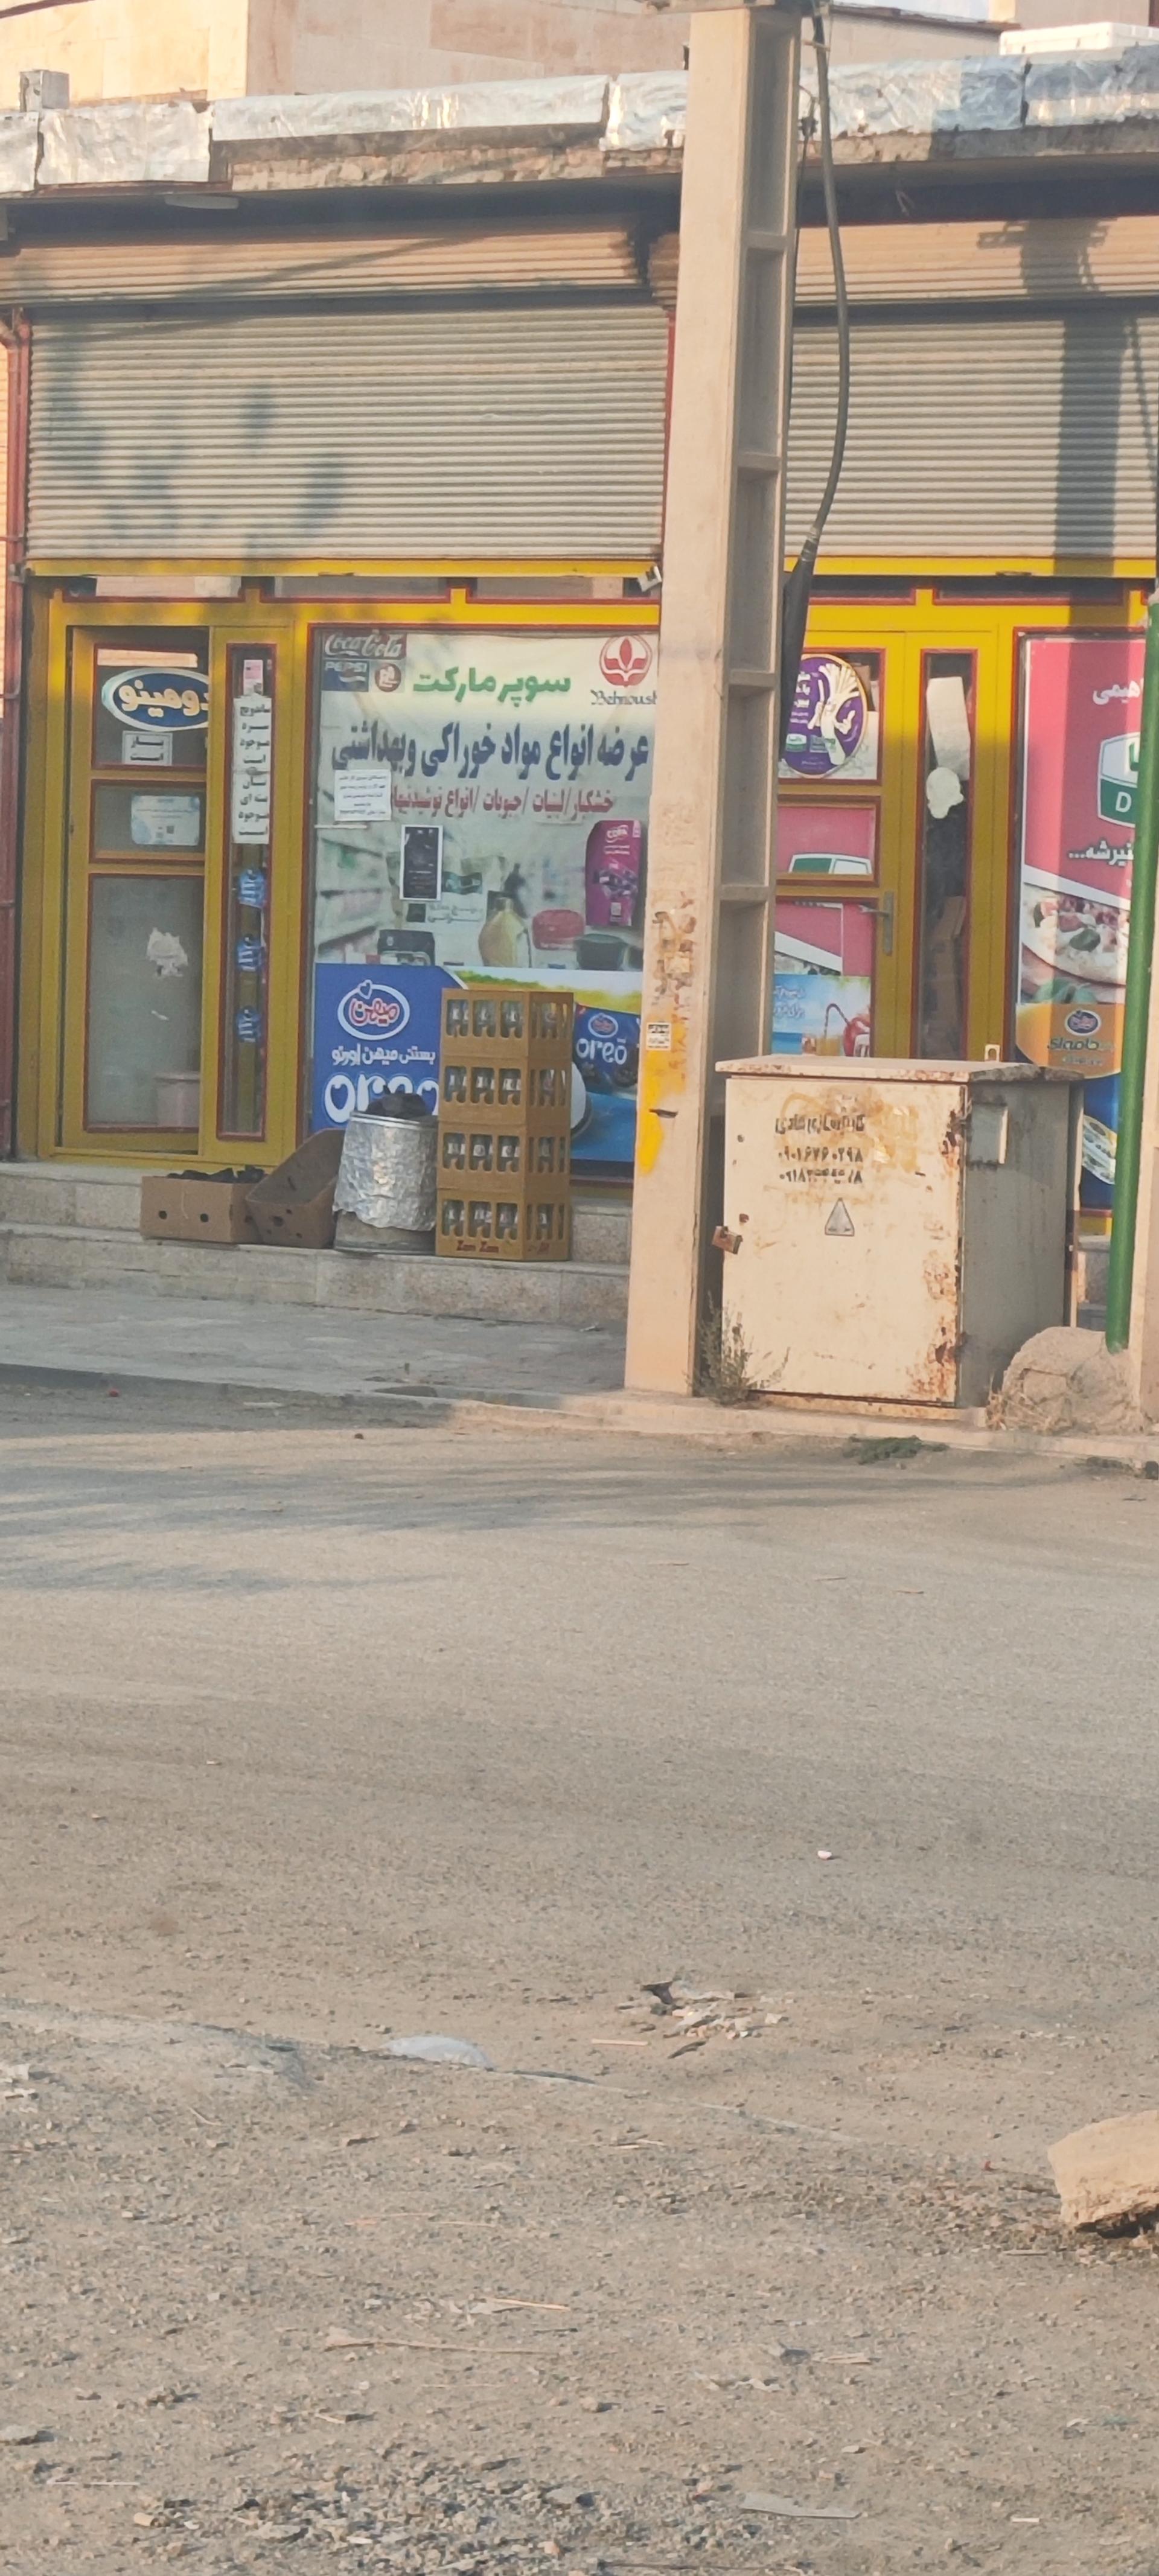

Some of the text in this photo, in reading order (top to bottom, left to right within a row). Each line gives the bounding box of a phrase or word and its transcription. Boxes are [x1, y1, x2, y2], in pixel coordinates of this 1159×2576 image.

[413, 666, 496, 703] مارکت
[497, 675, 571, 708] سوپر
[421, 721, 496, 779] خوراکی
[501, 722, 541, 780] مواد
[546, 723, 594, 781] انواع
[597, 725, 649, 782] عرضه
[362, 1046, 398, 1065] میهن
